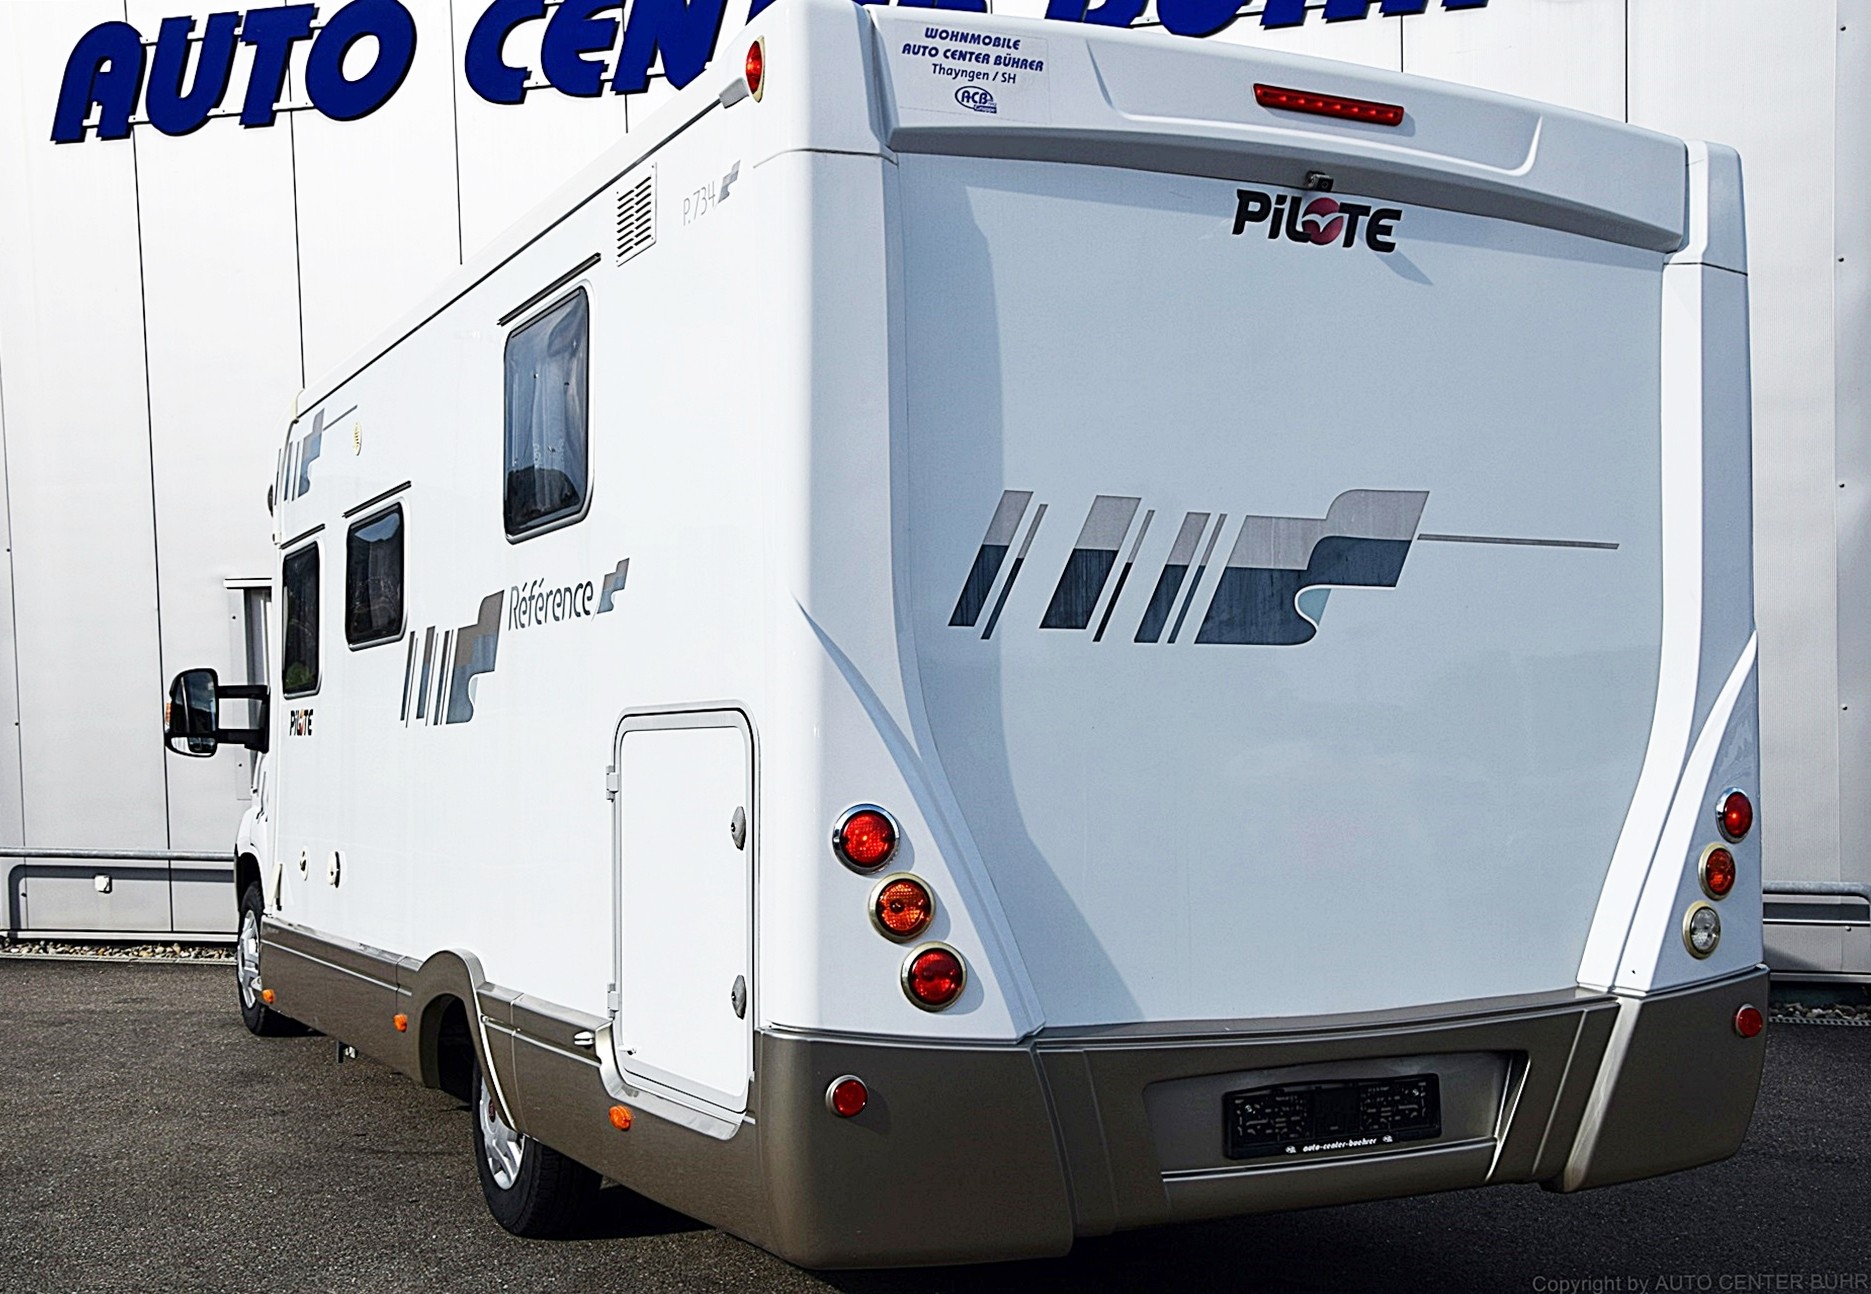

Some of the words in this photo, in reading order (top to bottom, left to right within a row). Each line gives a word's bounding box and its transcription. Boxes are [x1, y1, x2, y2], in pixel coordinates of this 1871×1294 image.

[924, 27, 1021, 50] WOHNMOBILE
[50, 0, 417, 144] AUTO
[902, 43, 940, 58] AUTO
[943, 48, 991, 65] CENTER
[993, 53, 1044, 72] BÜHRER
[932, 63, 989, 82] Thayngen
[1001, 72, 1017, 84] SH
[961, 90, 988, 104] ACB
[683, 180, 716, 226] P.734
[508, 577, 594, 631] Référence
